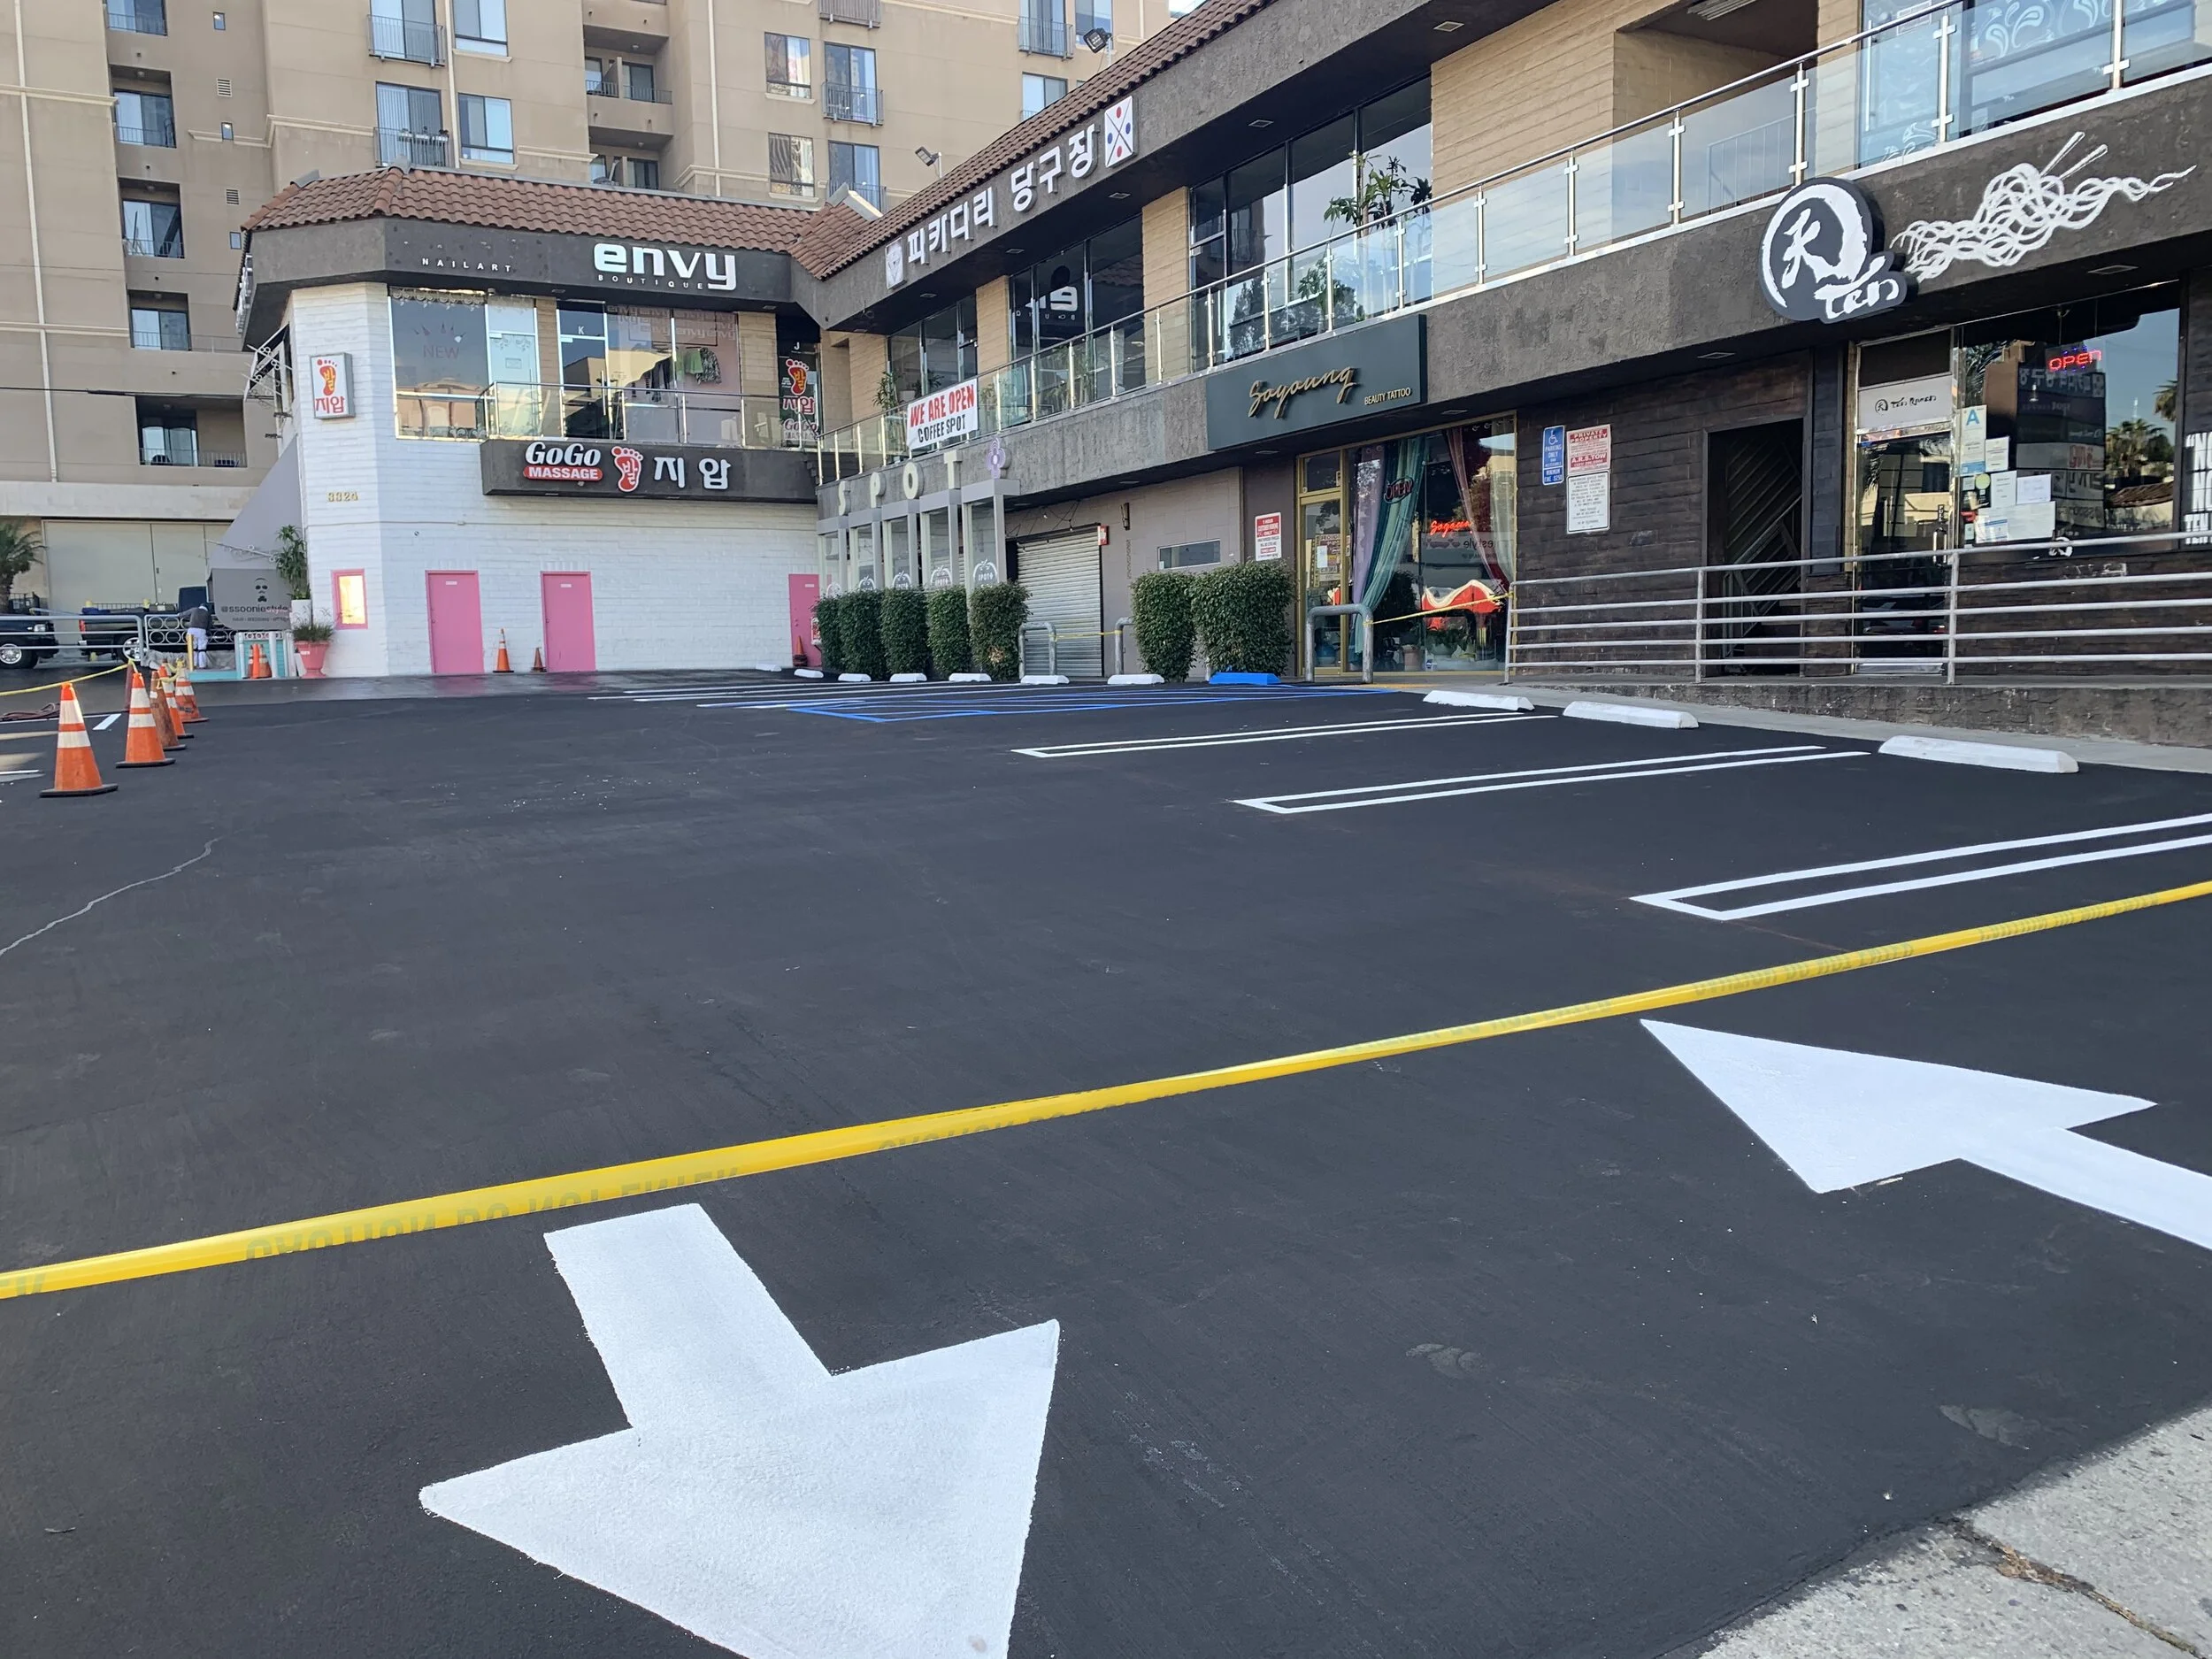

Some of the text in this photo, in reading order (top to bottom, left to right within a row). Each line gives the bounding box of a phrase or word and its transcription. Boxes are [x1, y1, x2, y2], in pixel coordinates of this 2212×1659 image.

[908, 123, 1096, 265] 피카디리 당구장
[594, 242, 737, 290] envy
[598, 274, 703, 290] BOUTIQUE
[1814, 255, 1900, 319] Ten
[423, 345, 460, 359] NEW
[323, 367, 335, 391] 발
[315, 396, 345, 413] 지압
[910, 384, 975, 427] WE ARE OPEN
[1364, 387, 1411, 405] BEAUTY TATTOO
[918, 414, 966, 443] COFFEE SPOT
[1966, 409, 1980, 426] A
[1571, 434, 1607, 443] PROPERTY
[1574, 430, 1603, 439] PRIVATE
[525, 442, 602, 467] GoGo
[528, 466, 599, 480] MASSAGE
[621, 457, 639, 486] 발
[838, 449, 958, 517] SPOT
